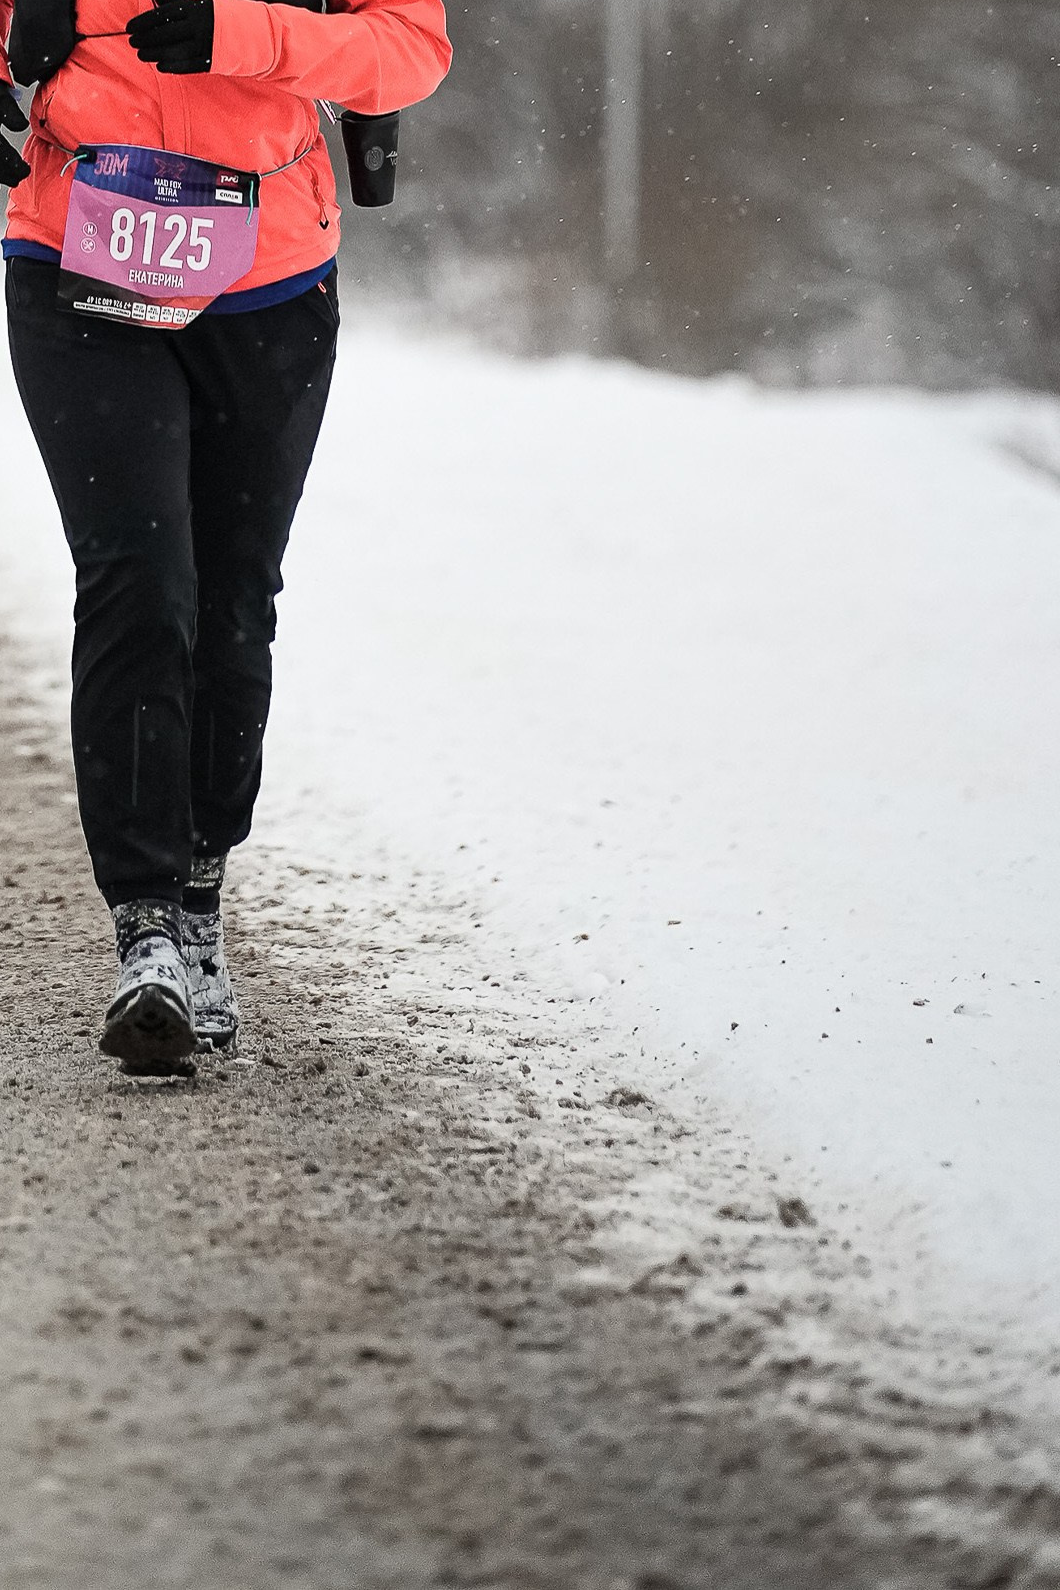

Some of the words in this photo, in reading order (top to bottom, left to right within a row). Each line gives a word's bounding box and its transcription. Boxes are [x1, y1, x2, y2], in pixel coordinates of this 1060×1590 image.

[153, 177, 169, 187] MAD
[169, 179, 182, 190] FOX
[157, 186, 178, 197] ULTRA
[110, 208, 214, 271] 8125
[128, 269, 184, 288] ЕКАТЕРИНА
